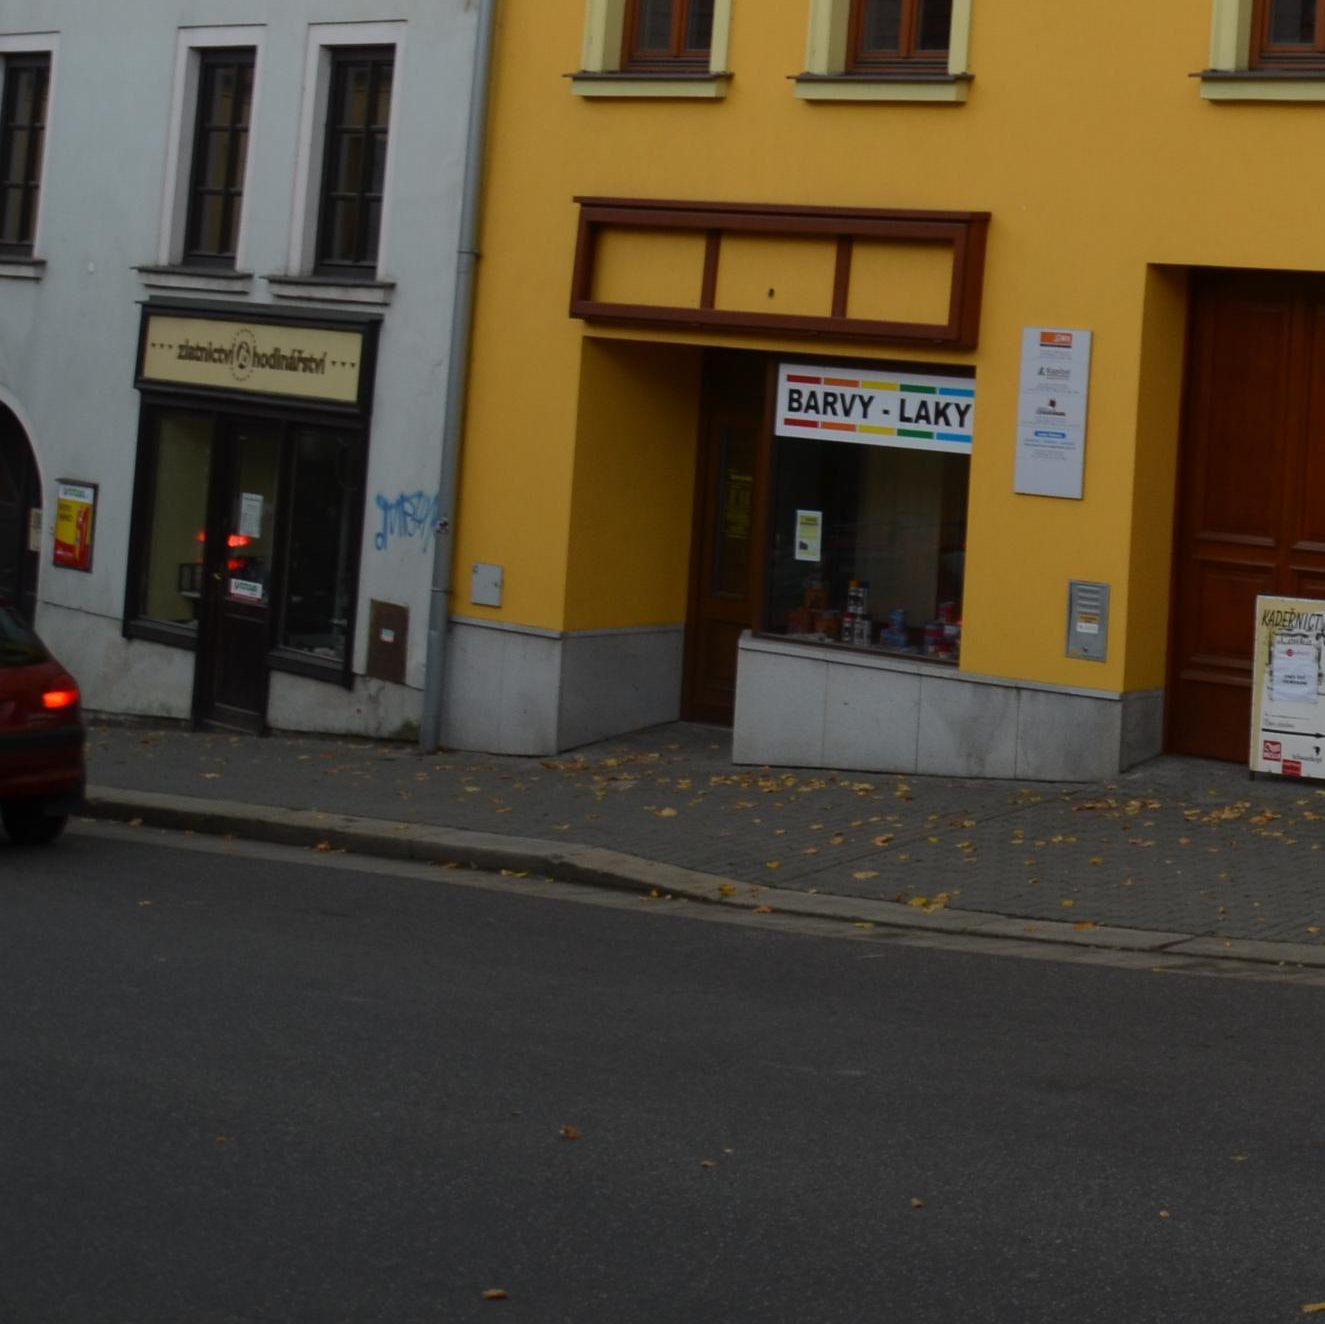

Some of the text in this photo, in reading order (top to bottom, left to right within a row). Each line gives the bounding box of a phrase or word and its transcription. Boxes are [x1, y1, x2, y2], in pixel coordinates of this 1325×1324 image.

[177, 339, 327, 376] zlatnictví hodinářství
[787, 388, 875, 420] BARVY
[898, 397, 972, 428] LAKY
